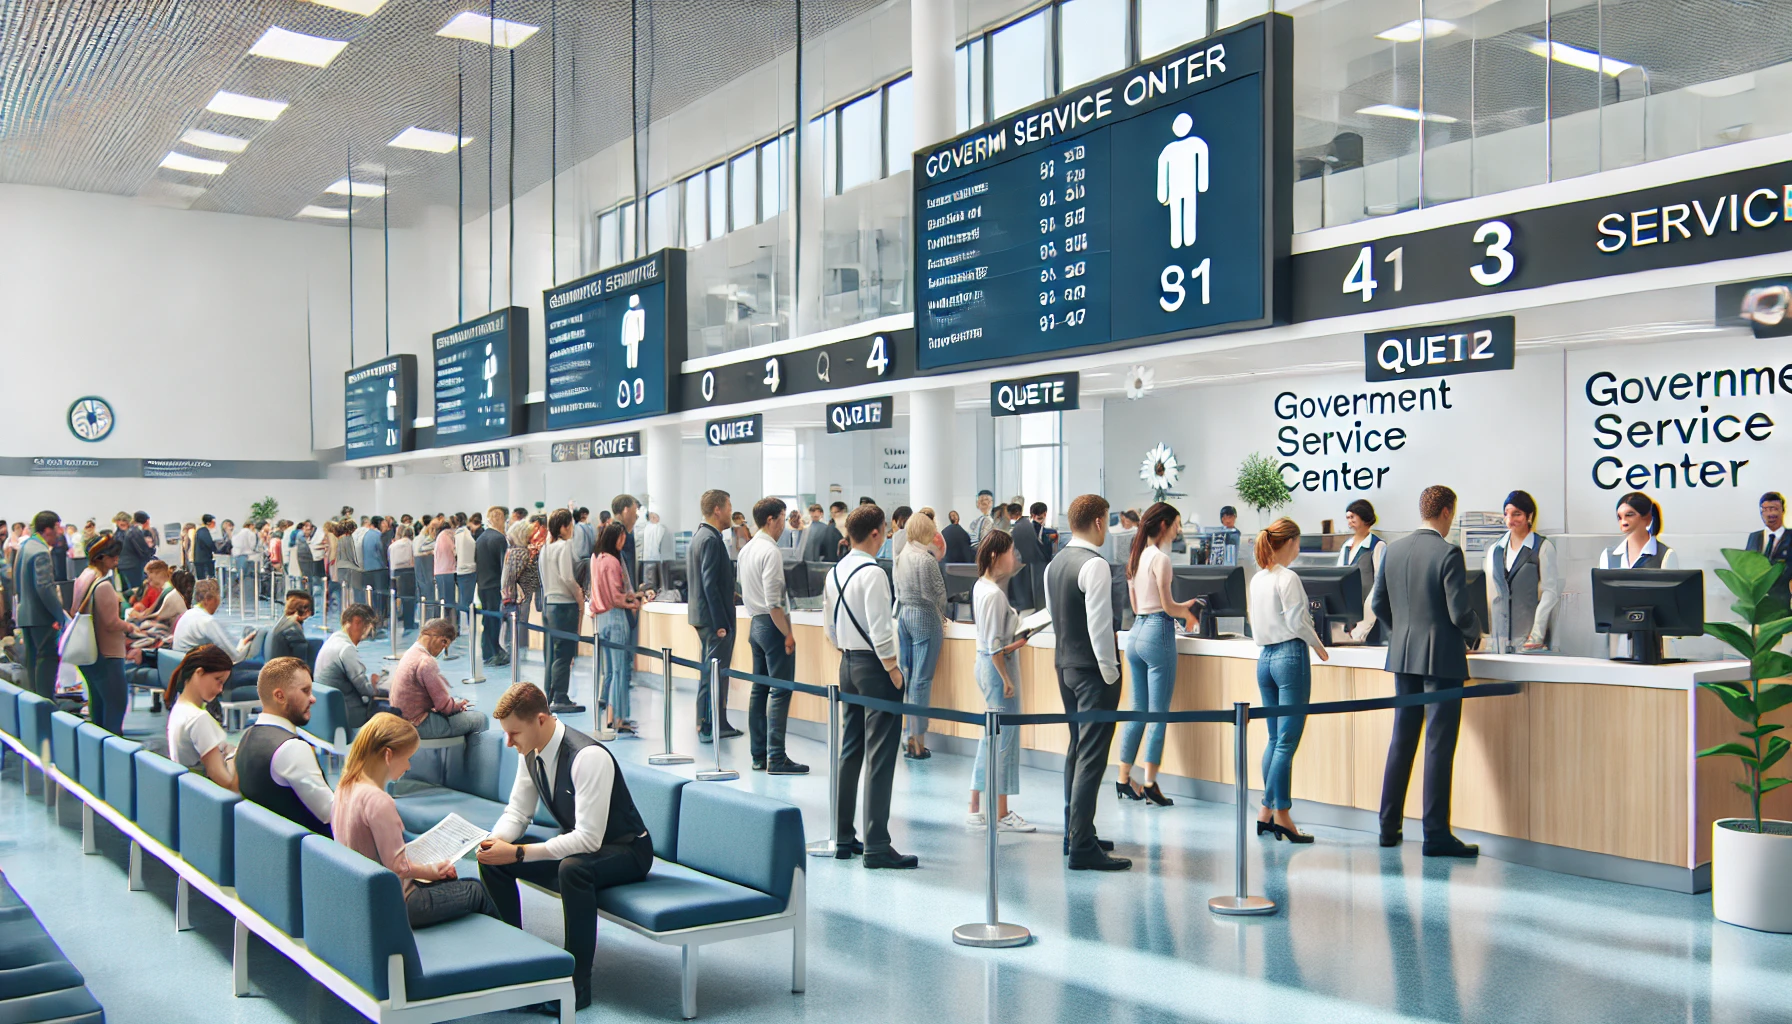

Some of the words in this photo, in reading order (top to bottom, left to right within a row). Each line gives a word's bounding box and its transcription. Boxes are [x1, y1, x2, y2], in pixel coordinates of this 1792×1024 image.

[1469, 220, 1515, 286] 3
[866, 336, 889, 376] 4
[998, 381, 1065, 412] QUETE
[1276, 420, 1407, 457] Service
[1593, 405, 1776, 449] Service
[1277, 461, 1390, 492] Center
[1591, 452, 1750, 490] Center
